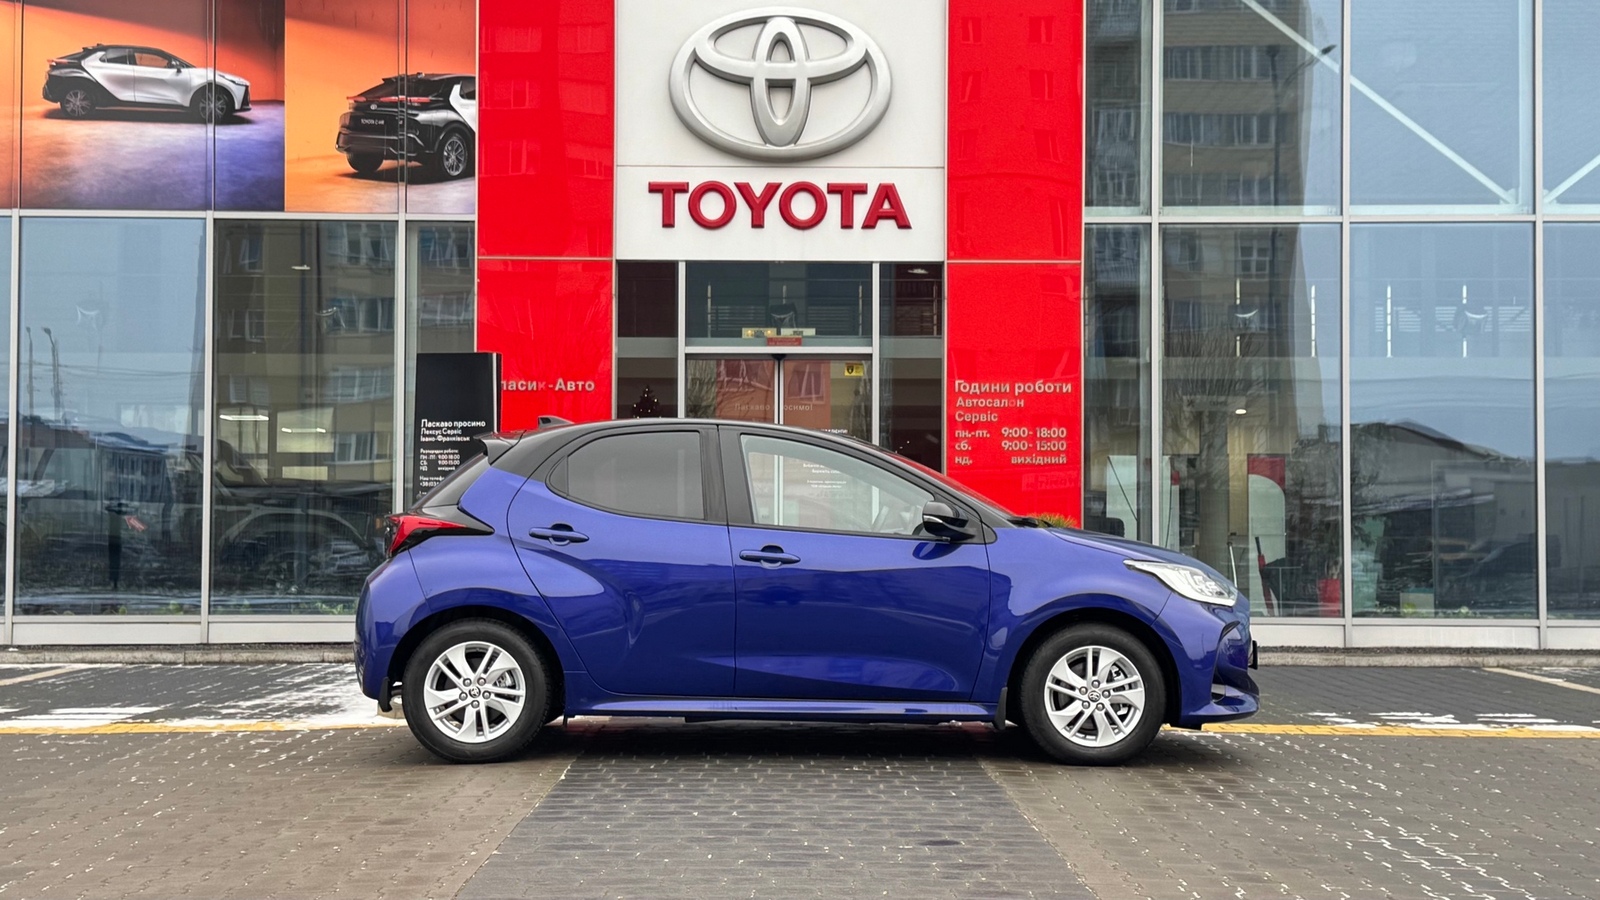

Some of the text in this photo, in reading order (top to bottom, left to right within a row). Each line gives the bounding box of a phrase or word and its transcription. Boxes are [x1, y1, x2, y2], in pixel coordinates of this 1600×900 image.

[648, 181, 912, 230] TOYOTA
[955, 380, 1072, 396] Години роботи
[956, 397, 1025, 407] Автосалон
[955, 411, 998, 424] Сервіс
[421, 419, 486, 429] Ласкаво просимо
[955, 429, 990, 438] пн.-пт.
[955, 440, 972, 451] сб.
[955, 454, 1067, 465] нд. вихідний
